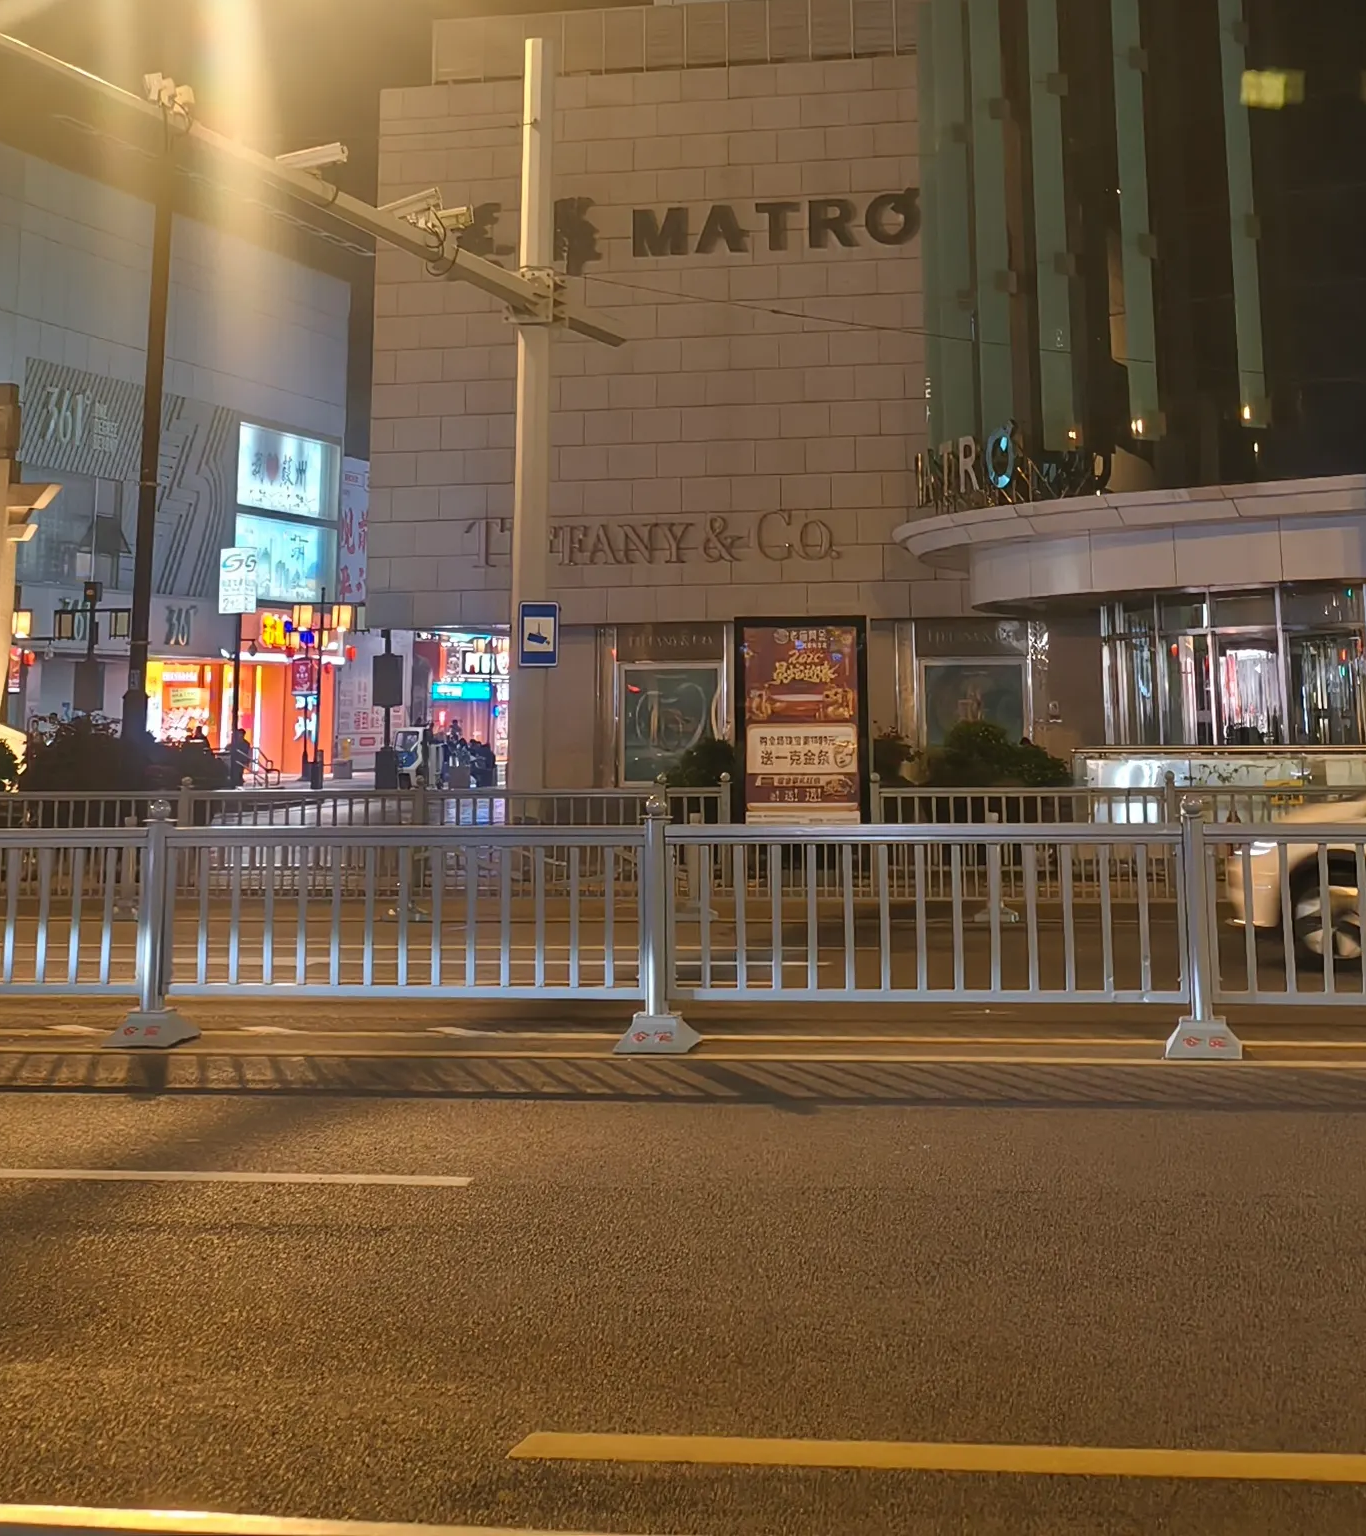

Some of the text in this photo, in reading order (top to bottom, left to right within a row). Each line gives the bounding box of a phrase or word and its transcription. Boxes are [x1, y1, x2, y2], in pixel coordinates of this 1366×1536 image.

[464, 518, 694, 569] TFANY
[761, 749, 830, 766] 送一克金条
